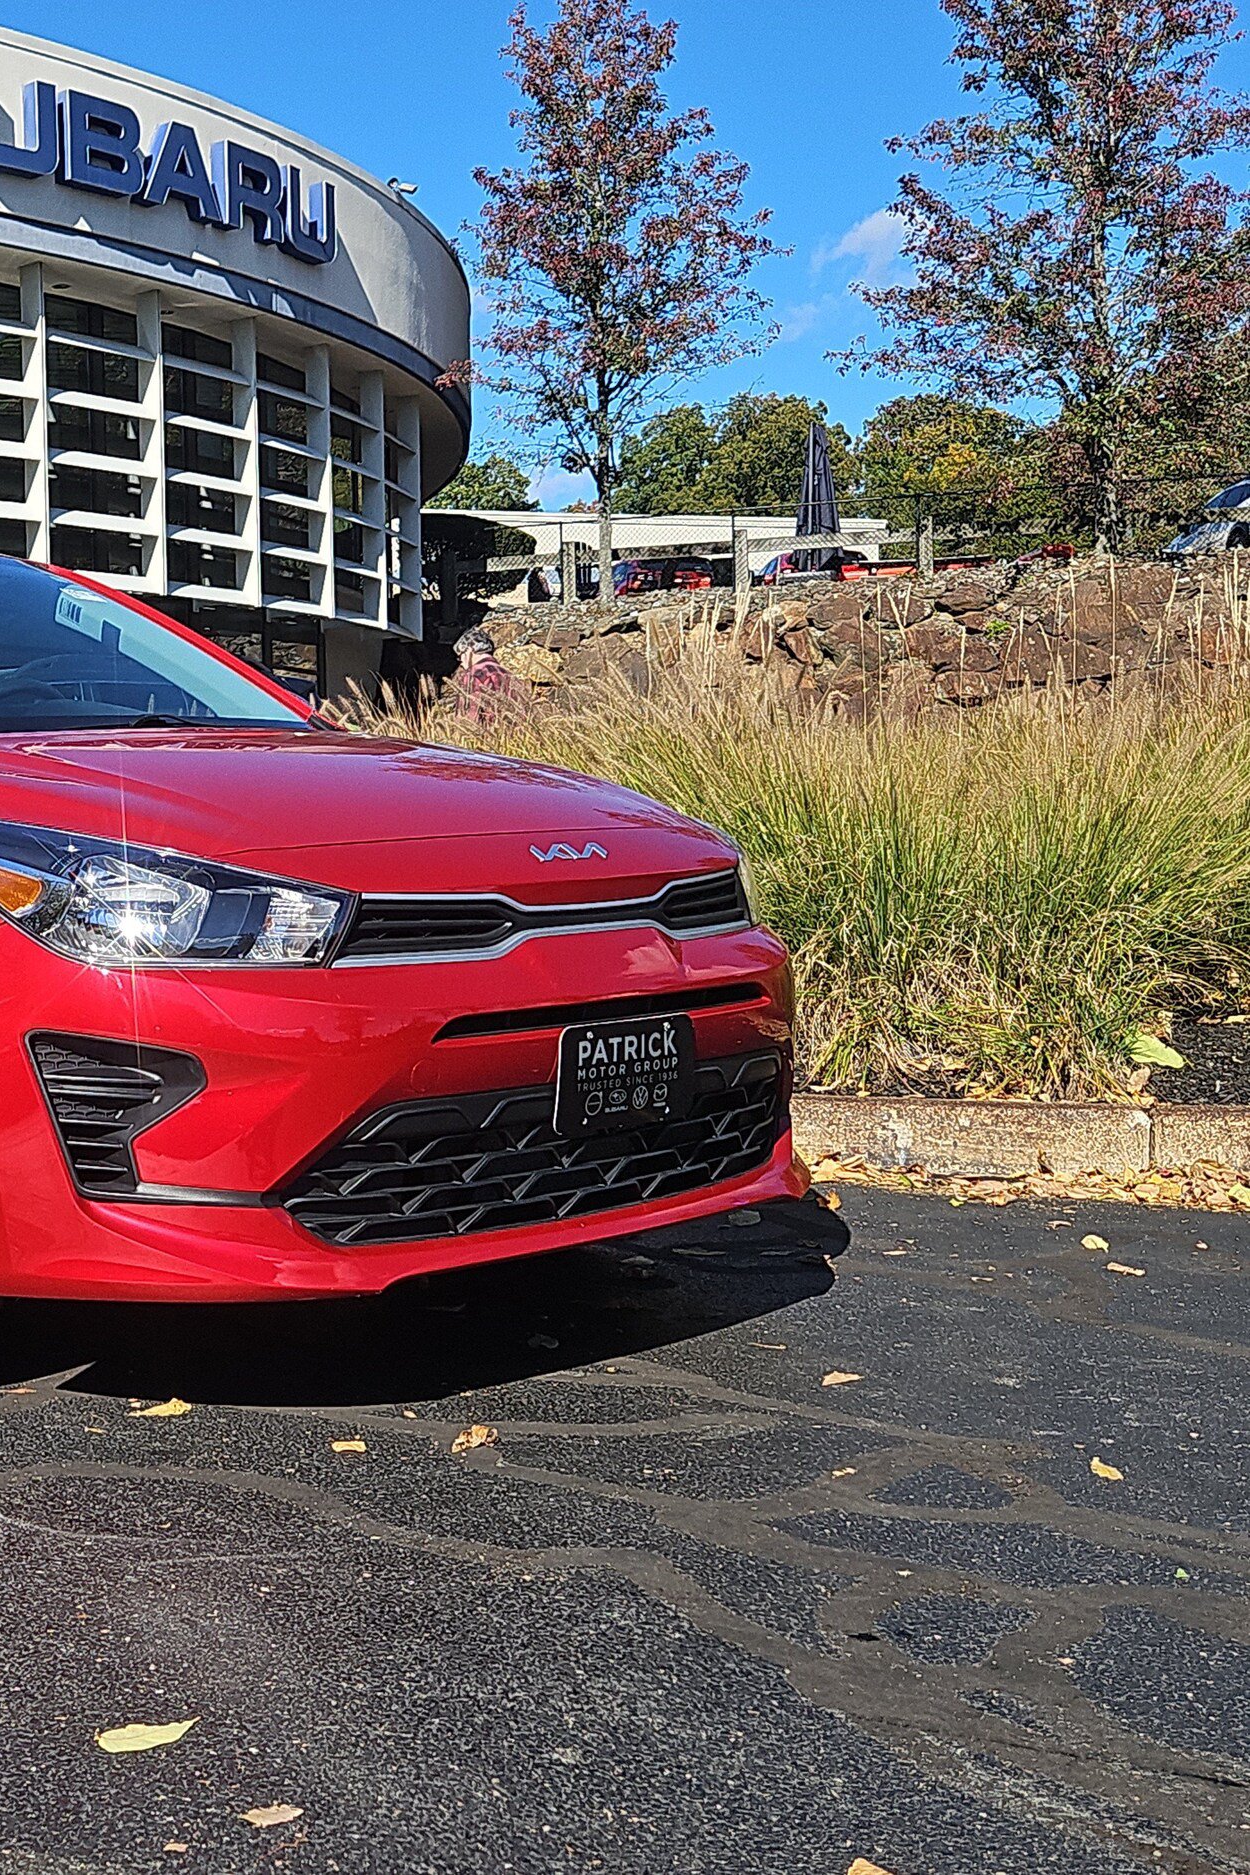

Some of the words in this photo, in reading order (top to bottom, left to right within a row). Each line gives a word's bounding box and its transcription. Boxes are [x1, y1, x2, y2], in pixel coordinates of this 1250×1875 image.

[530, 842, 607, 862] KIA
[578, 1030, 677, 1067] PATRICK
[577, 1064, 626, 1080] MOTOR
[634, 1057, 678, 1073] GROUP
[577, 1078, 621, 1092] TRUSTED
[626, 1073, 654, 1086] SINCE
[658, 1070, 678, 1081] 1936
